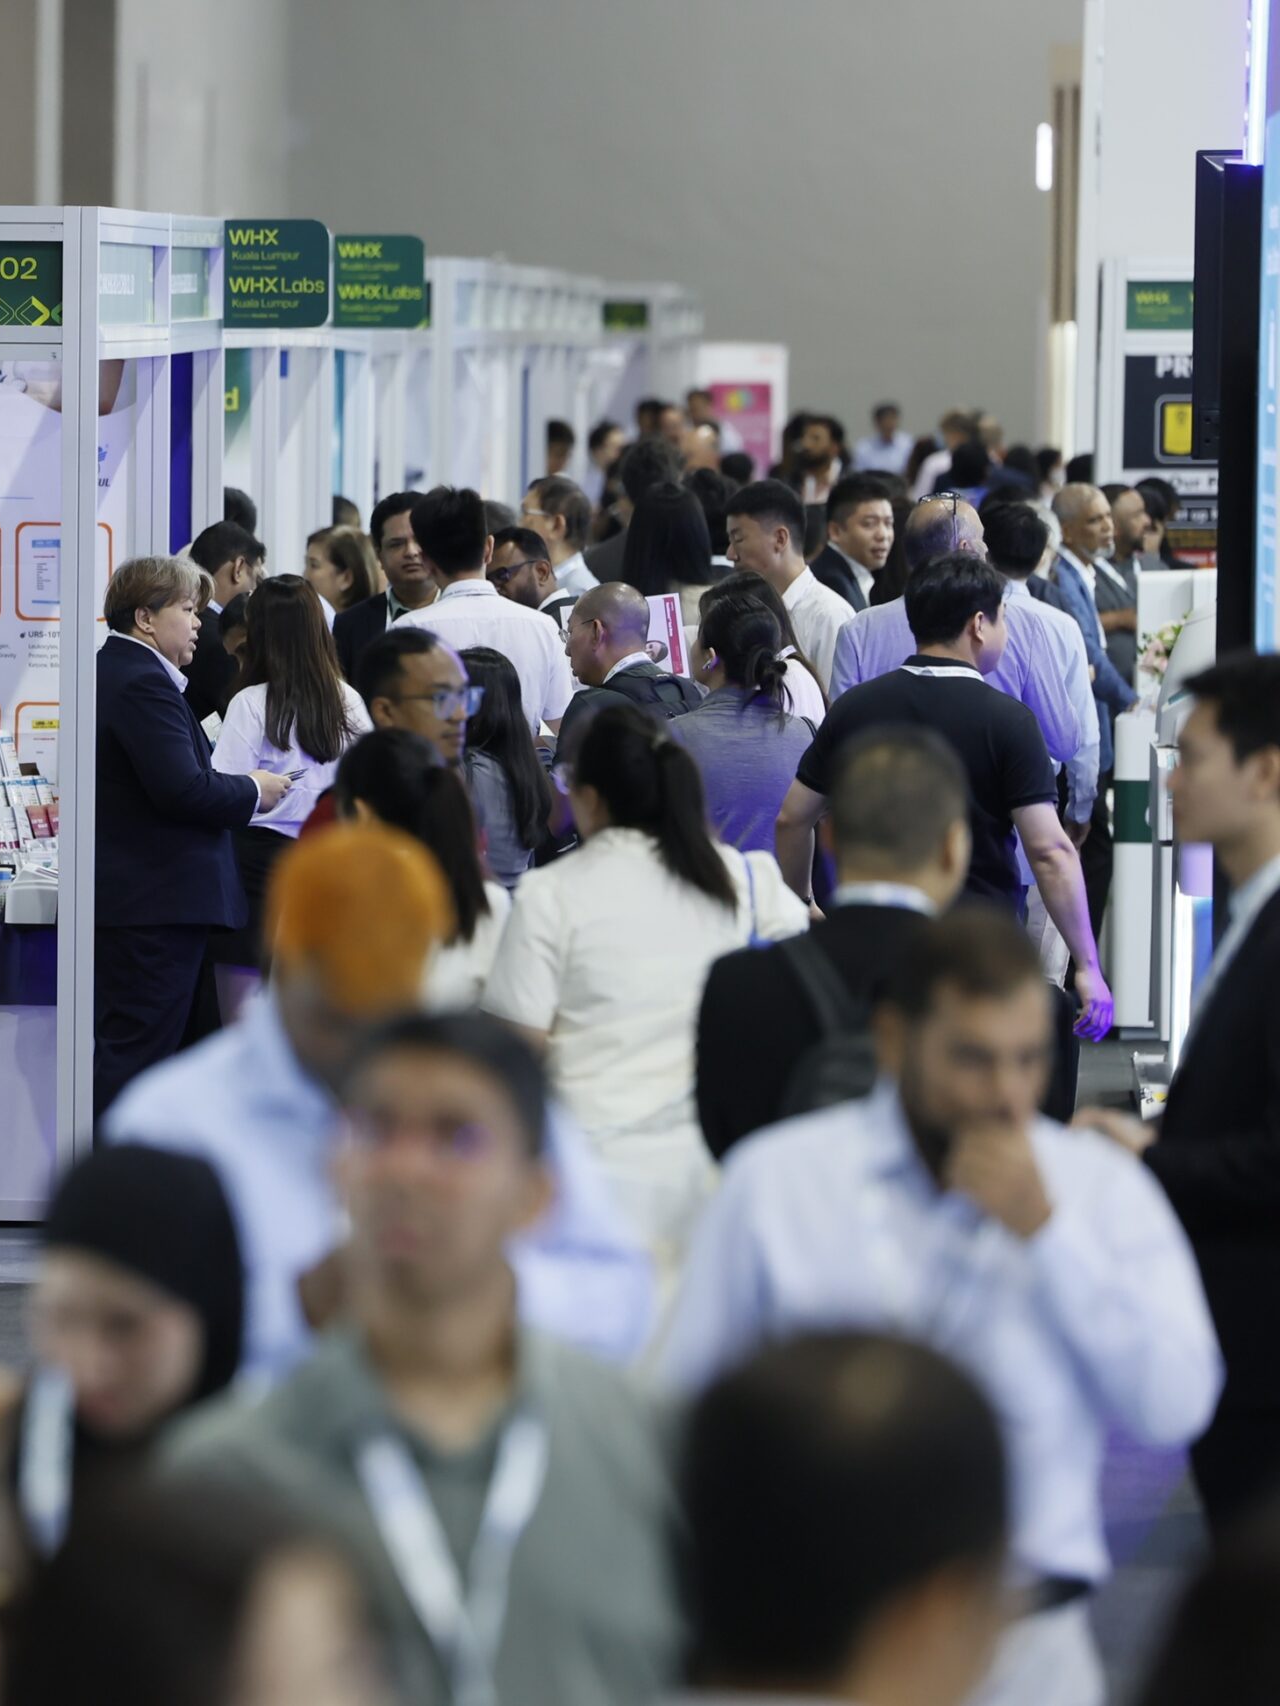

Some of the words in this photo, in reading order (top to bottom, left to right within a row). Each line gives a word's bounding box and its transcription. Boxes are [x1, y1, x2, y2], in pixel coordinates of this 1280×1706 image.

[229, 229, 278, 246] WHX
[232, 251, 259, 260] Kuala
[261, 251, 300, 262] Lumpur
[229, 277, 278, 294] WHX
[281, 277, 325, 294] Labs
[232, 299, 259, 308] Kuala
[1156, 356, 1193, 378] PR
